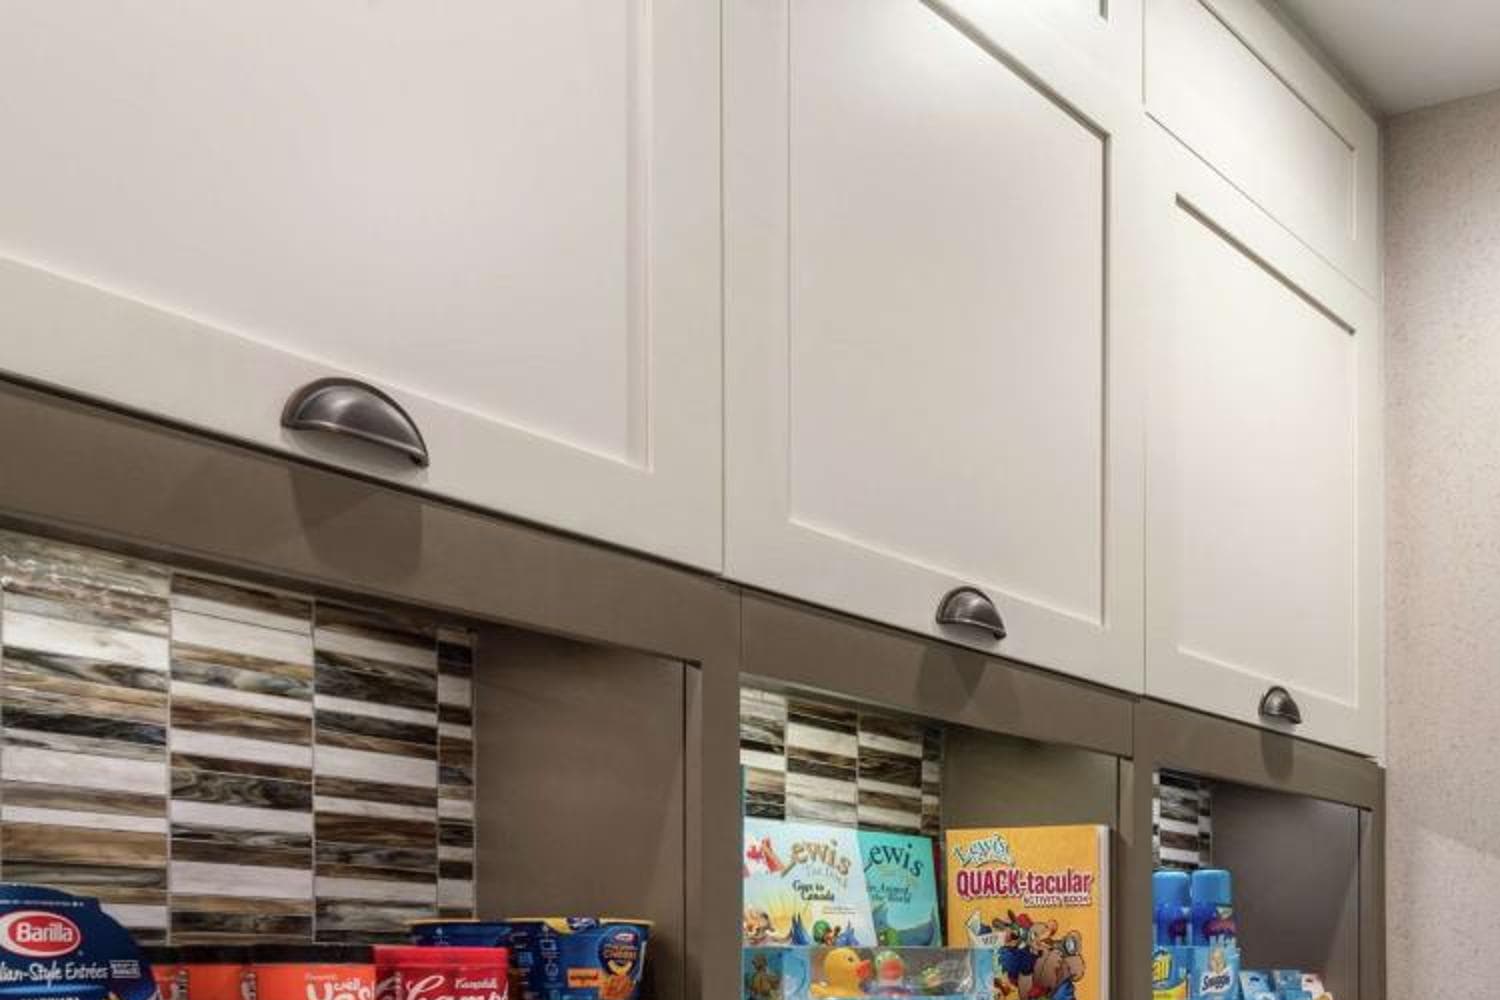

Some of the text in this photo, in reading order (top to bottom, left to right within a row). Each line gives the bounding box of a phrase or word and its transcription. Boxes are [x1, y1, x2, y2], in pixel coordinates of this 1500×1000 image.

[863, 842, 925, 878] ewis
[956, 866, 1094, 899] QUACK-tacular
[15, 921, 74, 944] Barilla
